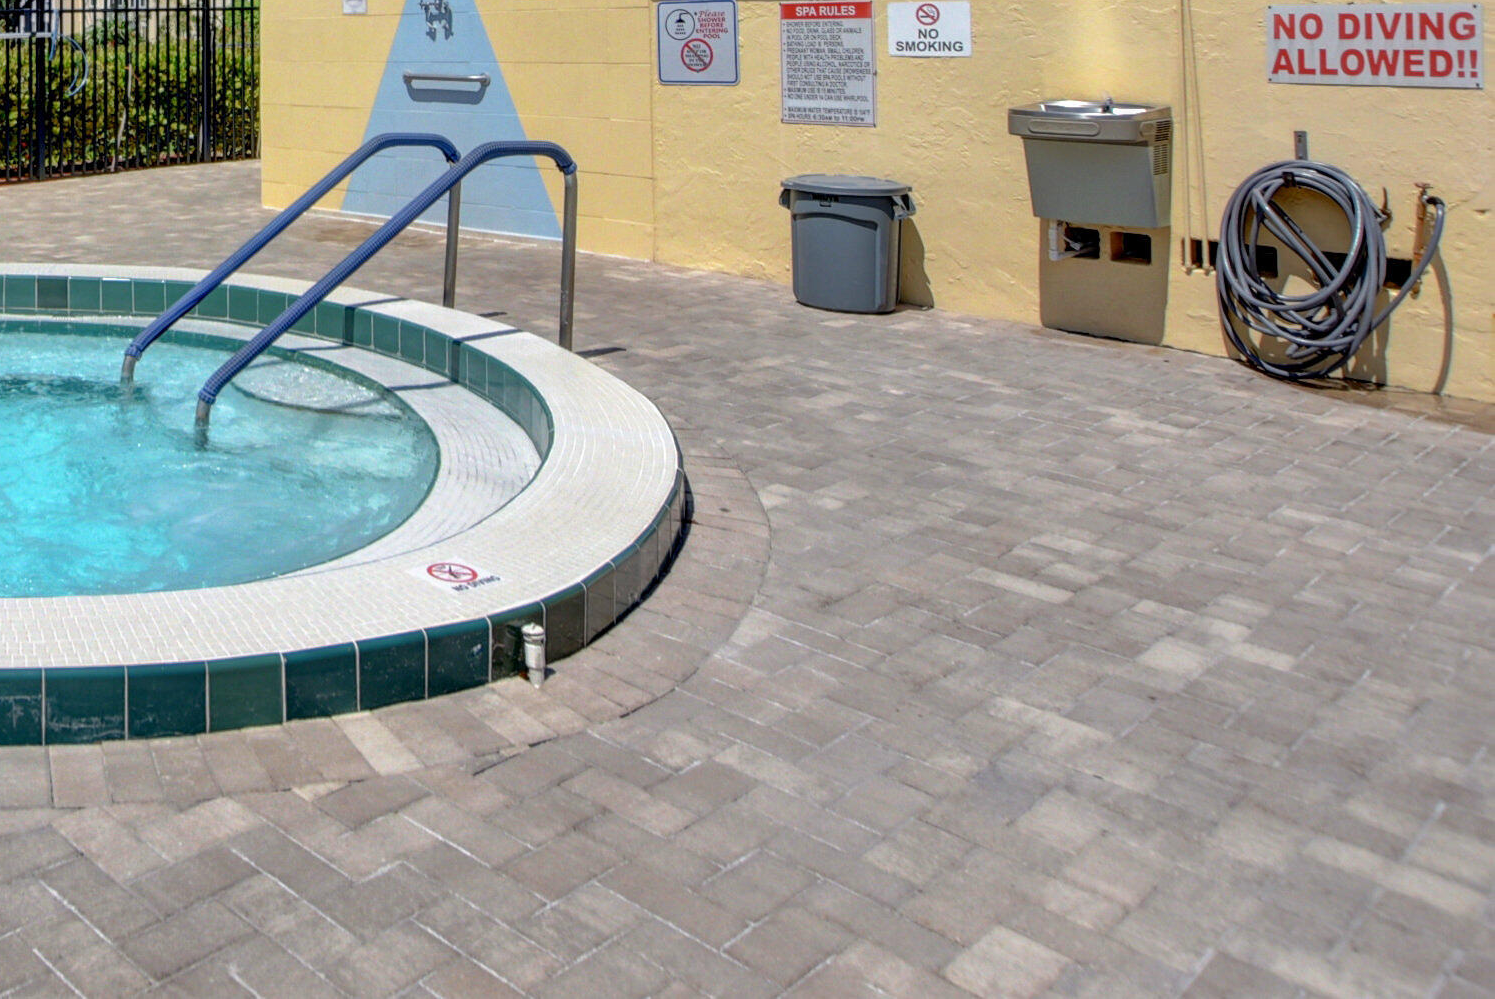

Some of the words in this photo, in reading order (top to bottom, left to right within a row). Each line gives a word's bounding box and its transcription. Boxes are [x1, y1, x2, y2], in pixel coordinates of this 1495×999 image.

[795, 6, 817, 16] SPA
[819, 5, 856, 16] RULES
[1273, 13, 1323, 40] NO
[1338, 12, 1476, 40] DIVING
[918, 29, 939, 39] NO
[896, 41, 963, 51] SMOKING
[1271, 49, 1478, 78] ALLOWED!!
